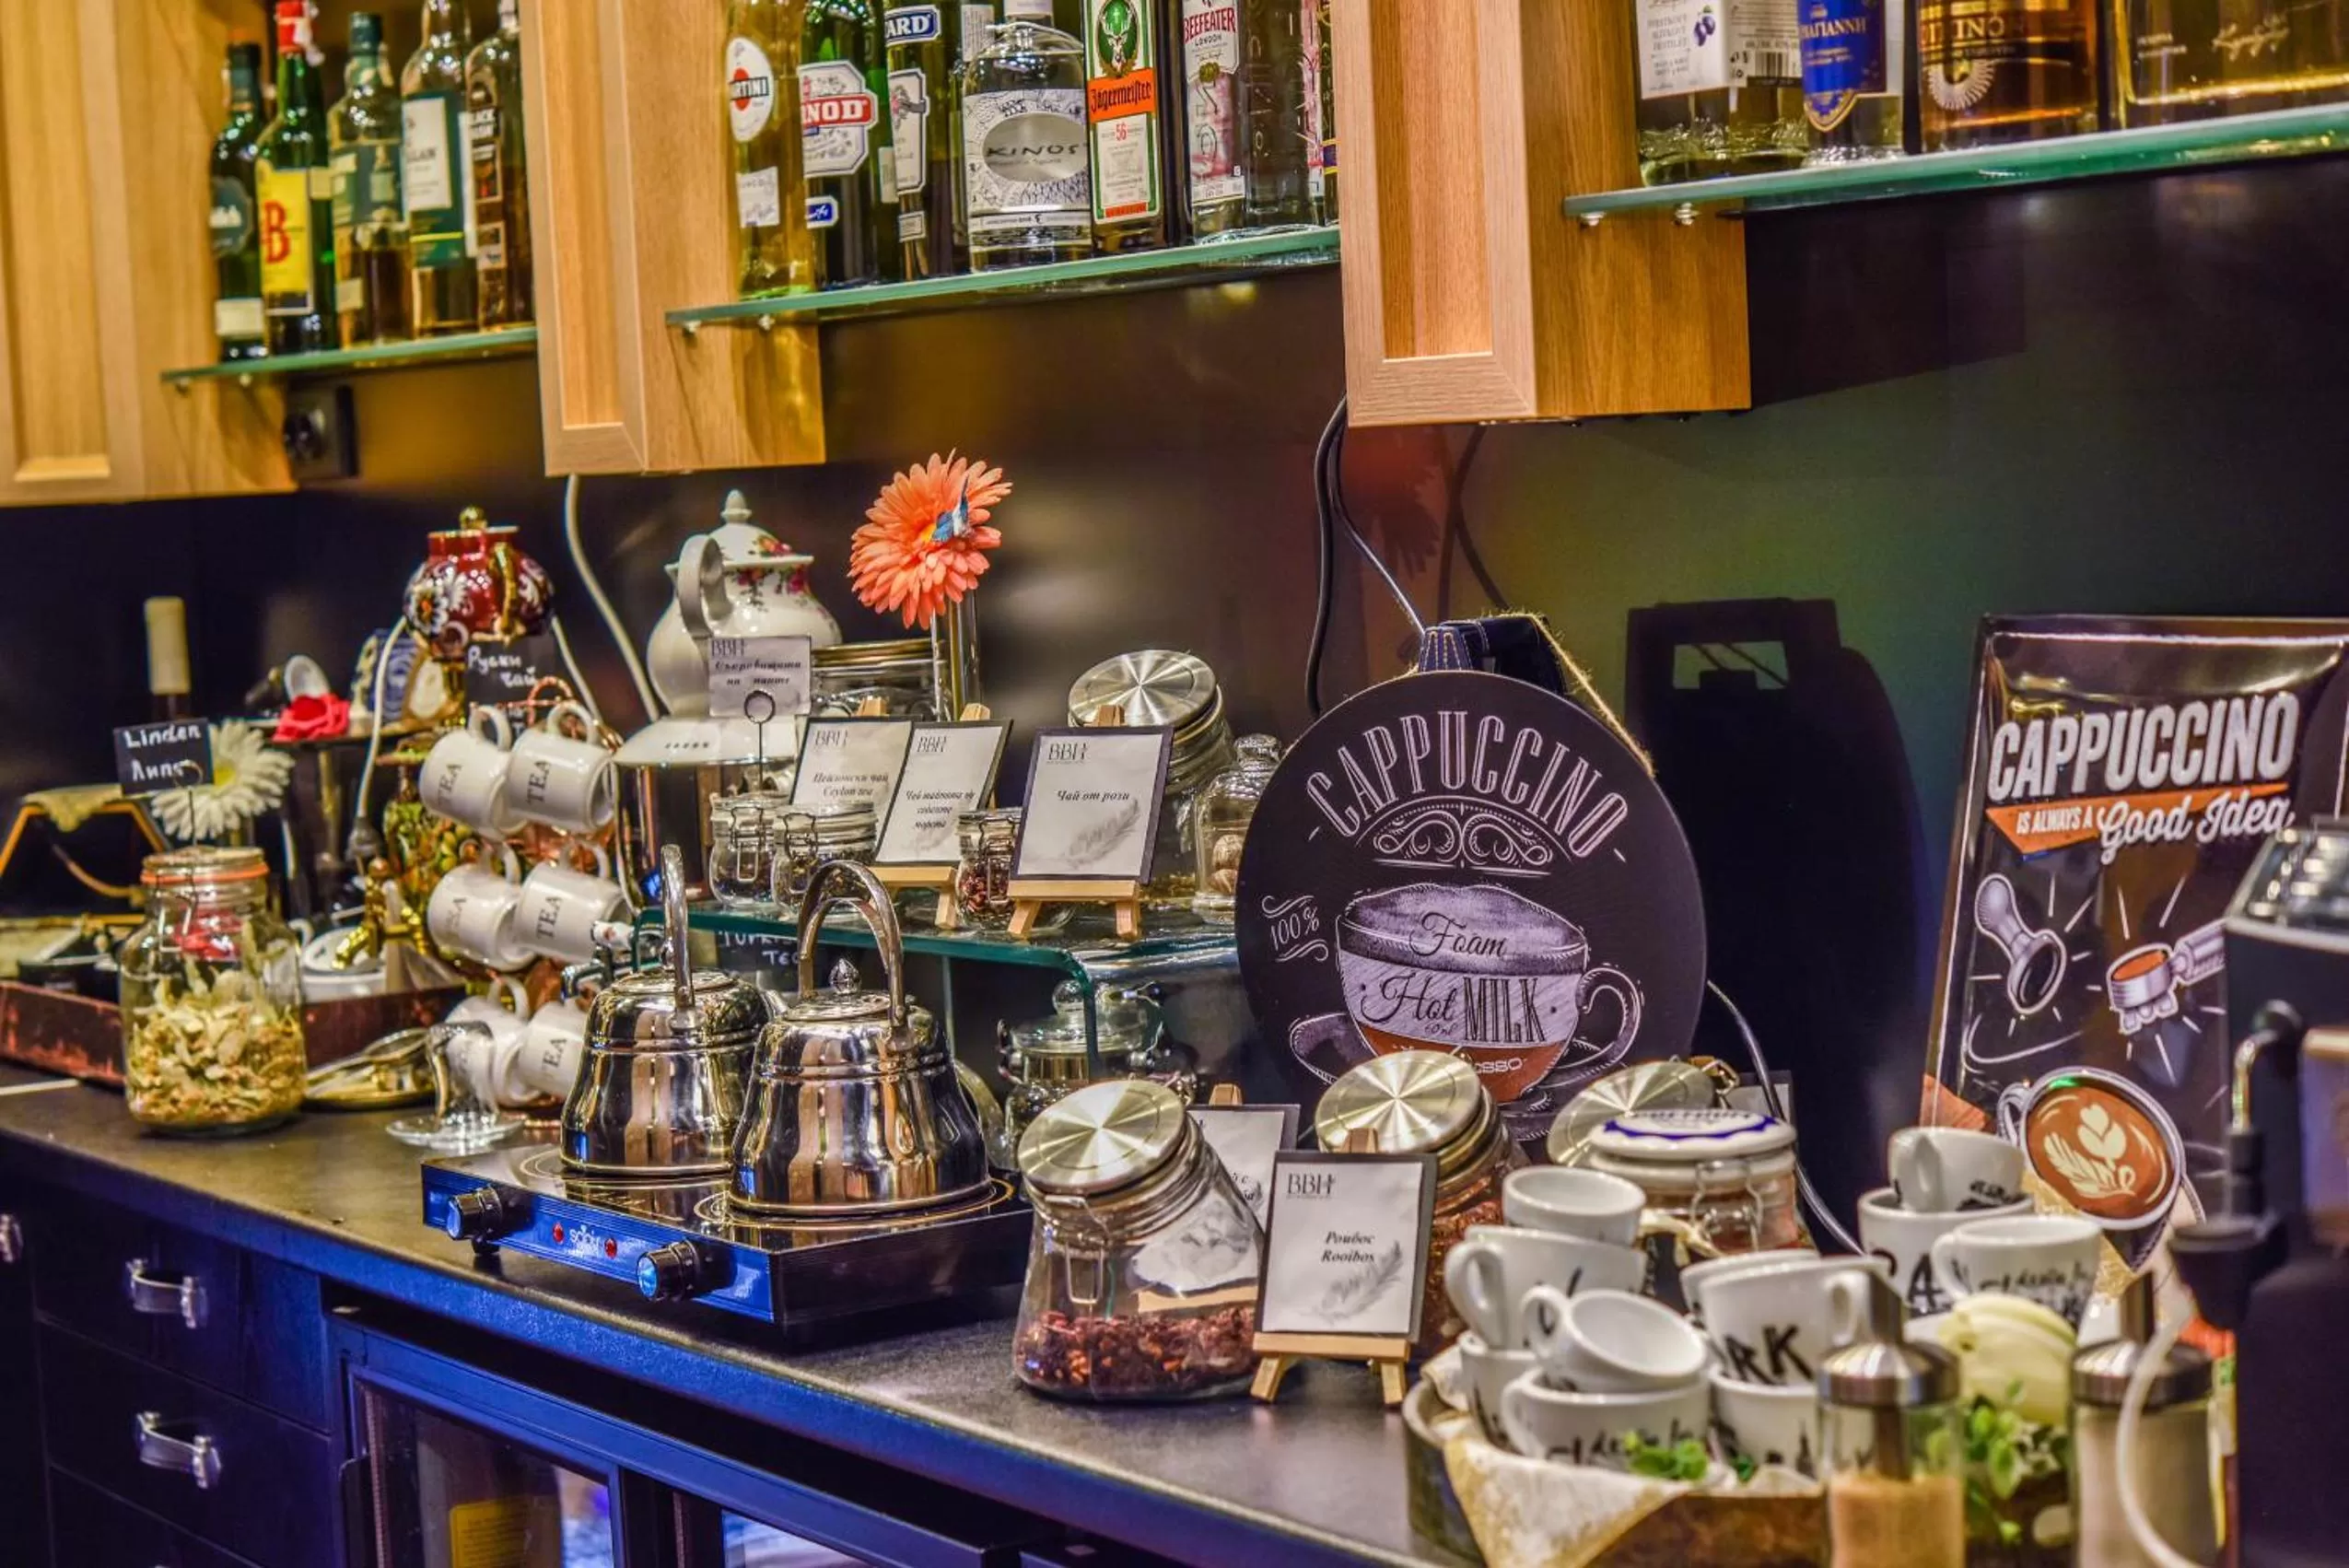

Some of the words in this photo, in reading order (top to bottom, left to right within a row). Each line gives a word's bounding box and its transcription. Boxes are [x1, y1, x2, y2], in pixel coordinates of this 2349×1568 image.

[884, 13, 932, 39] ARD
[1183, 7, 1236, 42] BEEFEATER
[1195, 34, 1223, 46] LONDON
[803, 99, 865, 123] NOD
[711, 638, 744, 657] BBH
[123, 724, 202, 748] Linden
[1048, 742, 1087, 760] BBH
[1986, 691, 2300, 802] CAPPUCCINO
[438, 763, 462, 806] TEA
[526, 759, 551, 803] TEA
[1058, 790, 1080, 801] Чай
[1081, 792, 1100, 801] от
[1101, 792, 1129, 802] рози
[1306, 710, 1629, 859] CAPPUCCINO
[2016, 813, 2030, 835] IS
[2031, 807, 2083, 834] ALWAYS
[2082, 806, 2094, 830] A
[2097, 795, 2193, 866] Good
[2196, 789, 2296, 843] Idea
[536, 895, 564, 940] TEA
[1270, 906, 1320, 952] 100%
[1408, 911, 1507, 958] Foam
[1361, 972, 1458, 1023] Hot
[1463, 977, 1547, 1044] MILK
[1288, 1172, 1334, 1195] BBH
[1321, 1248, 1374, 1263] Rooibos
